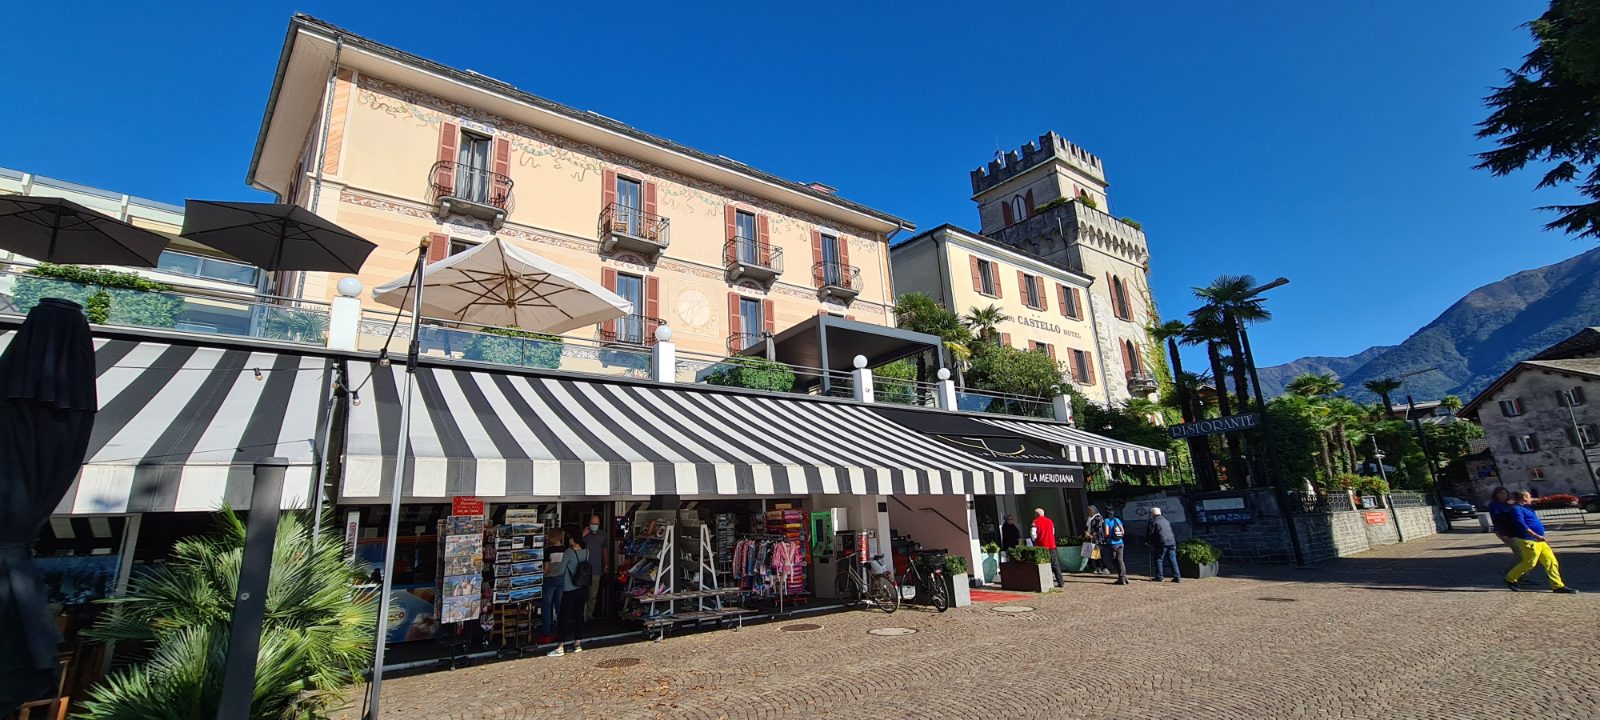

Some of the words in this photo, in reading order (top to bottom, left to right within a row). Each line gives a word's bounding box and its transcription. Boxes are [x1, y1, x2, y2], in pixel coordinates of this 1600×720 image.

[1017, 315, 1061, 334] CASTELLO
[1063, 329, 1082, 340] HOTEL
[1172, 415, 1255, 437] RISTORANTE
[1029, 473, 1038, 483] LA
[1039, 473, 1075, 484] MERIDIANA
